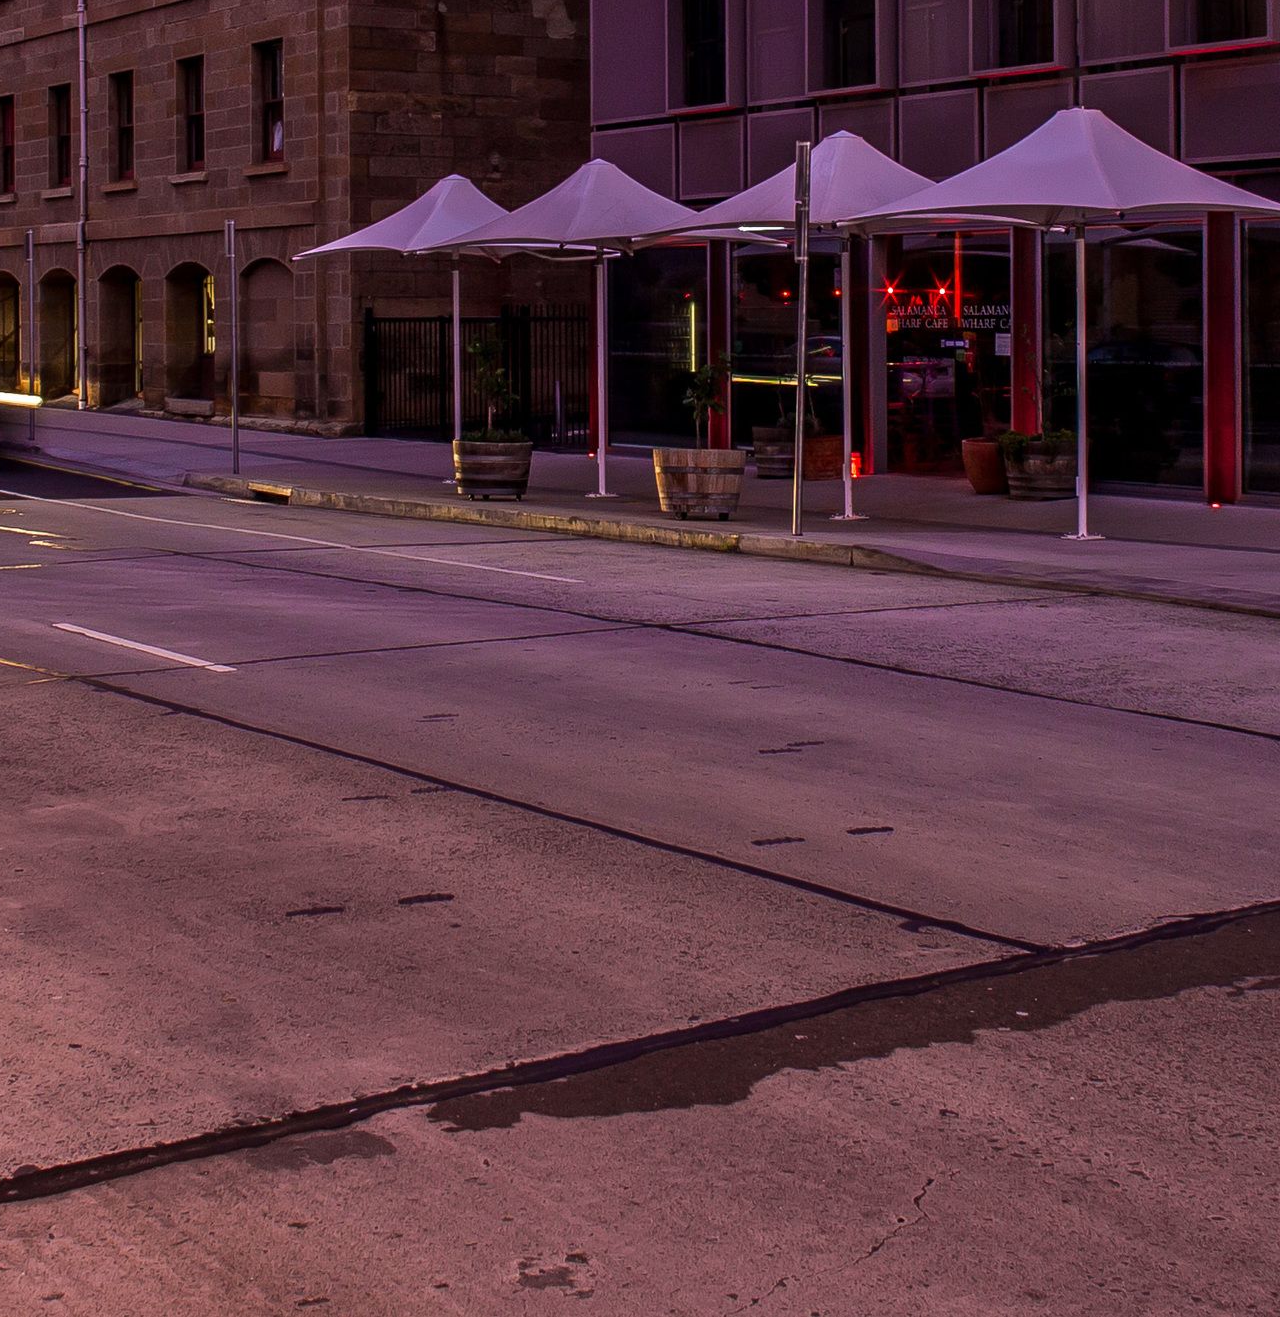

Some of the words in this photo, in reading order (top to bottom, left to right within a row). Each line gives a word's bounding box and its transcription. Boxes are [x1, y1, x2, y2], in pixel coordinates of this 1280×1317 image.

[891, 305, 947, 315] SALAMANCA
[963, 305, 1010, 316] SALAMAN
[890, 318, 923, 328] HARF
[925, 318, 949, 329] CAFE
[961, 318, 996, 329] WHARF
